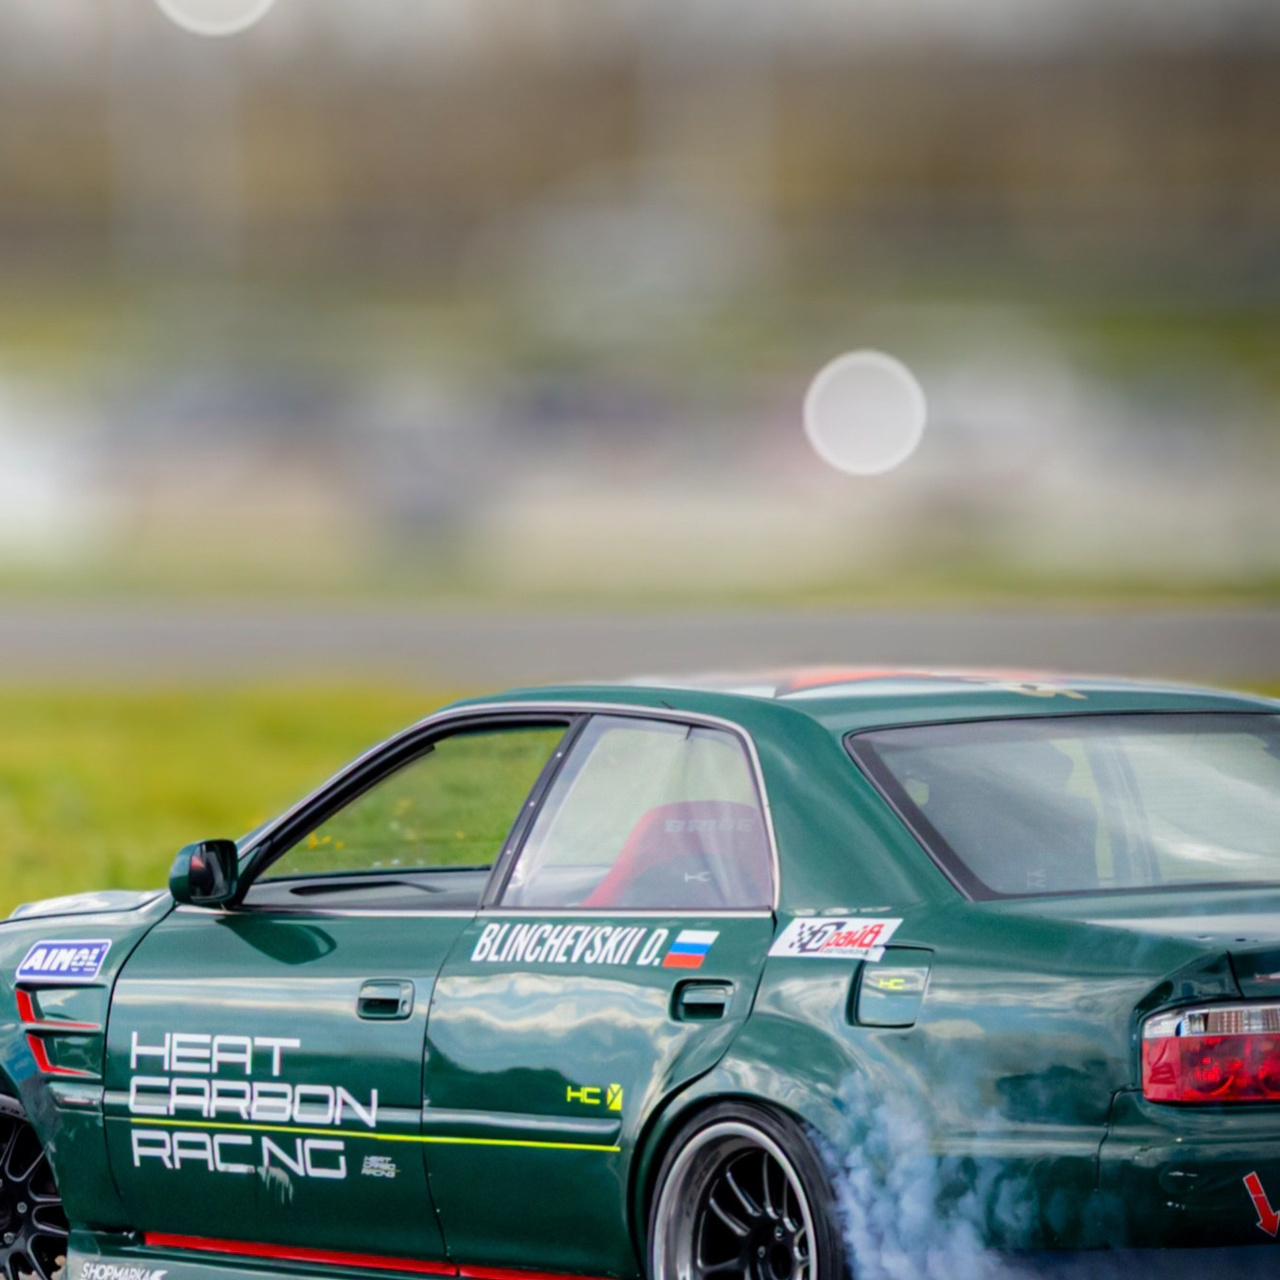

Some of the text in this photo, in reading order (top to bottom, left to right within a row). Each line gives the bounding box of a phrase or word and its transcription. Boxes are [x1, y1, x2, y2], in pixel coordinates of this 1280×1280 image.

[22, 947, 101, 972] AIMOL
[636, 927, 670, 966] D.
[130, 1031, 301, 1076] HEAT
[128, 1075, 378, 1128] CARBON
[567, 1085, 601, 1105] HC
